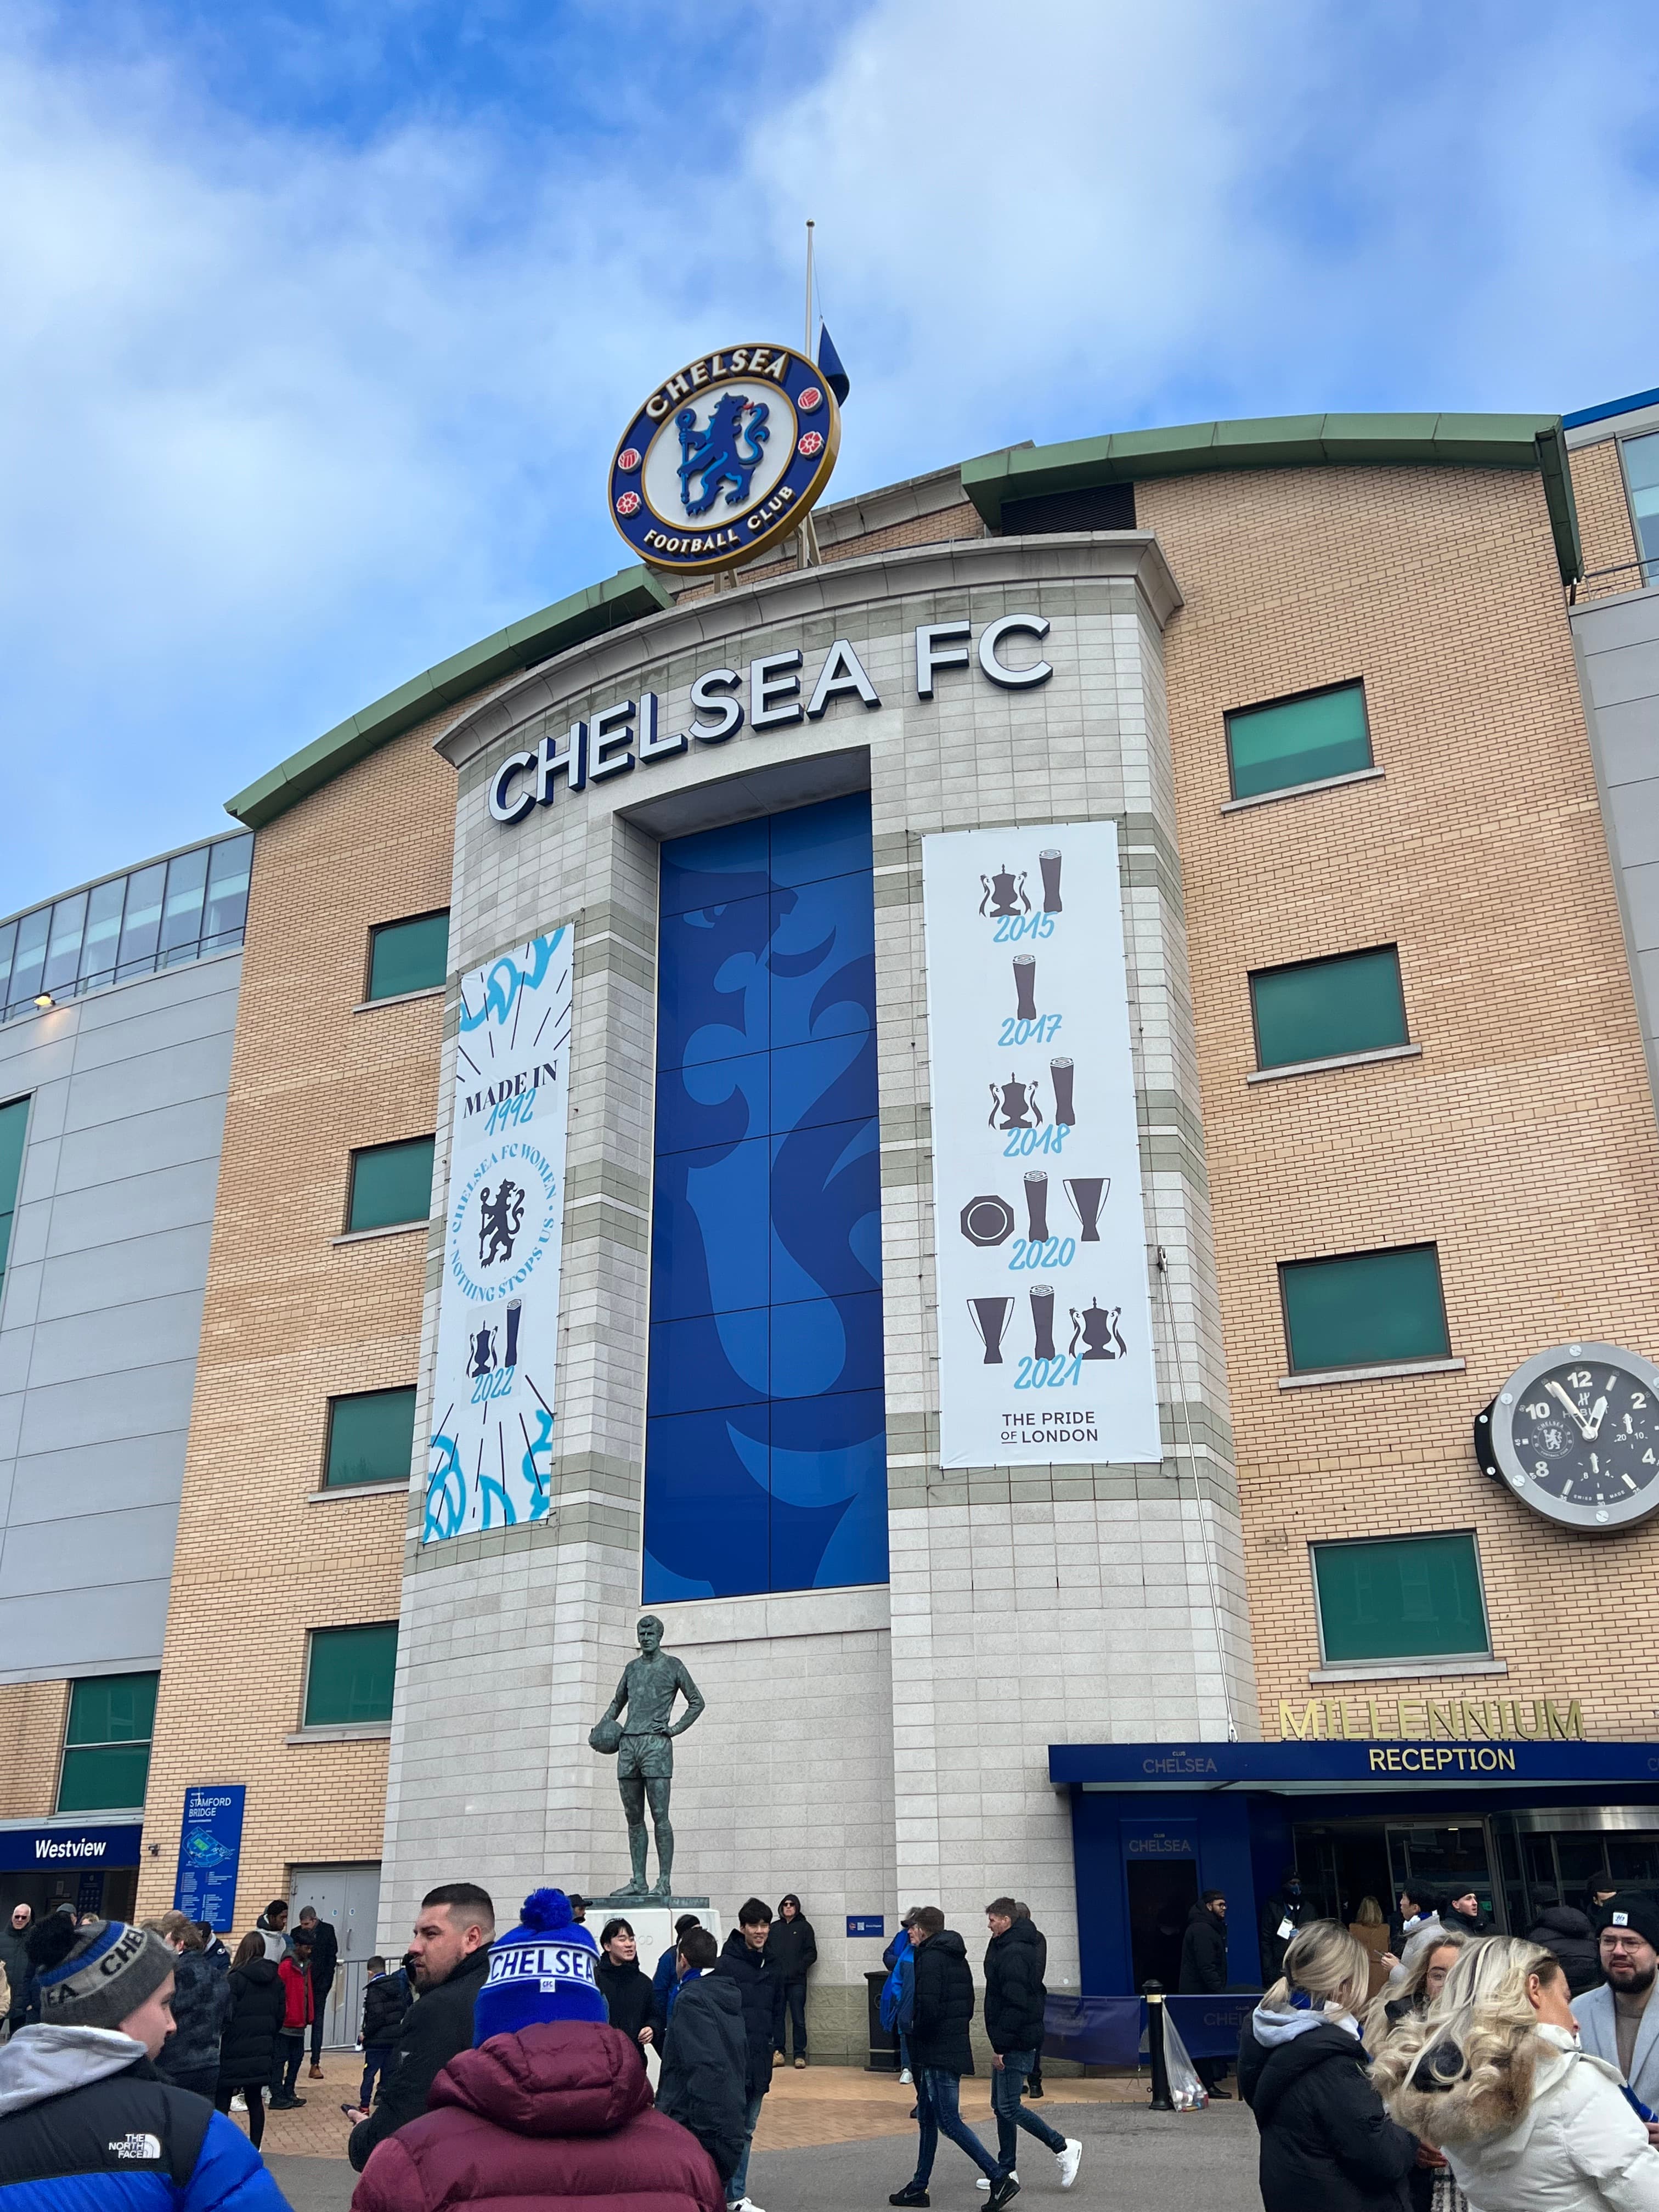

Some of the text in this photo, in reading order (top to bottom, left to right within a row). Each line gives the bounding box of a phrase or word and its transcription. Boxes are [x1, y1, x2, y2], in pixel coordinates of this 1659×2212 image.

[646, 349, 788, 419] CHELSEA
[644, 486, 794, 555] FOOTBALL CLUB
[488, 613, 1053, 825] CHELSEA FC
[993, 911, 1058, 942] 2015
[997, 1014, 1062, 1046] 2017
[462, 1059, 558, 1119] MADE IN
[484, 1087, 536, 1136] 1992
[1003, 1123, 1070, 1157] 2018
[452, 1143, 556, 1233] CHELSEA FC WOMEN
[450, 1217, 554, 1301] NOTHING STOPS US
[1008, 1236, 1075, 1270] 2020
[1014, 1353, 1084, 1389] 2021
[1567, 1371, 1593, 1388] 12
[471, 1365, 514, 1404] 2022
[1526, 1402, 1550, 1420] 10
[1630, 1392, 1647, 1409] 2
[1002, 1411, 1095, 1426] THE PRIDE
[1537, 1420, 1564, 1431] CHELSEA
[1001, 1429, 1098, 1443] OF LONDON
[1642, 1448, 1656, 1464] 4
[1536, 1461, 1549, 1477] 8
[1610, 1490, 1625, 1499] MADE
[1279, 1700, 1585, 1740] MILLENNIUM
[1143, 1758, 1217, 1773] CHELSEA
[1369, 1748, 1516, 1771] RECEPTION
[189, 1808, 216, 1817] BRIDGE
[190, 1797, 231, 1808] STAMFORD
[35, 1838, 106, 1859] Westview
[1129, 1839, 1191, 1852] CHELSEA
[99, 1929, 145, 1976] CHE
[491, 1949, 594, 1983] CHELSEA
[109, 2142, 144, 2150] NORTH
[125, 2134, 145, 2142] THE
[118, 2151, 143, 2159] FACE
